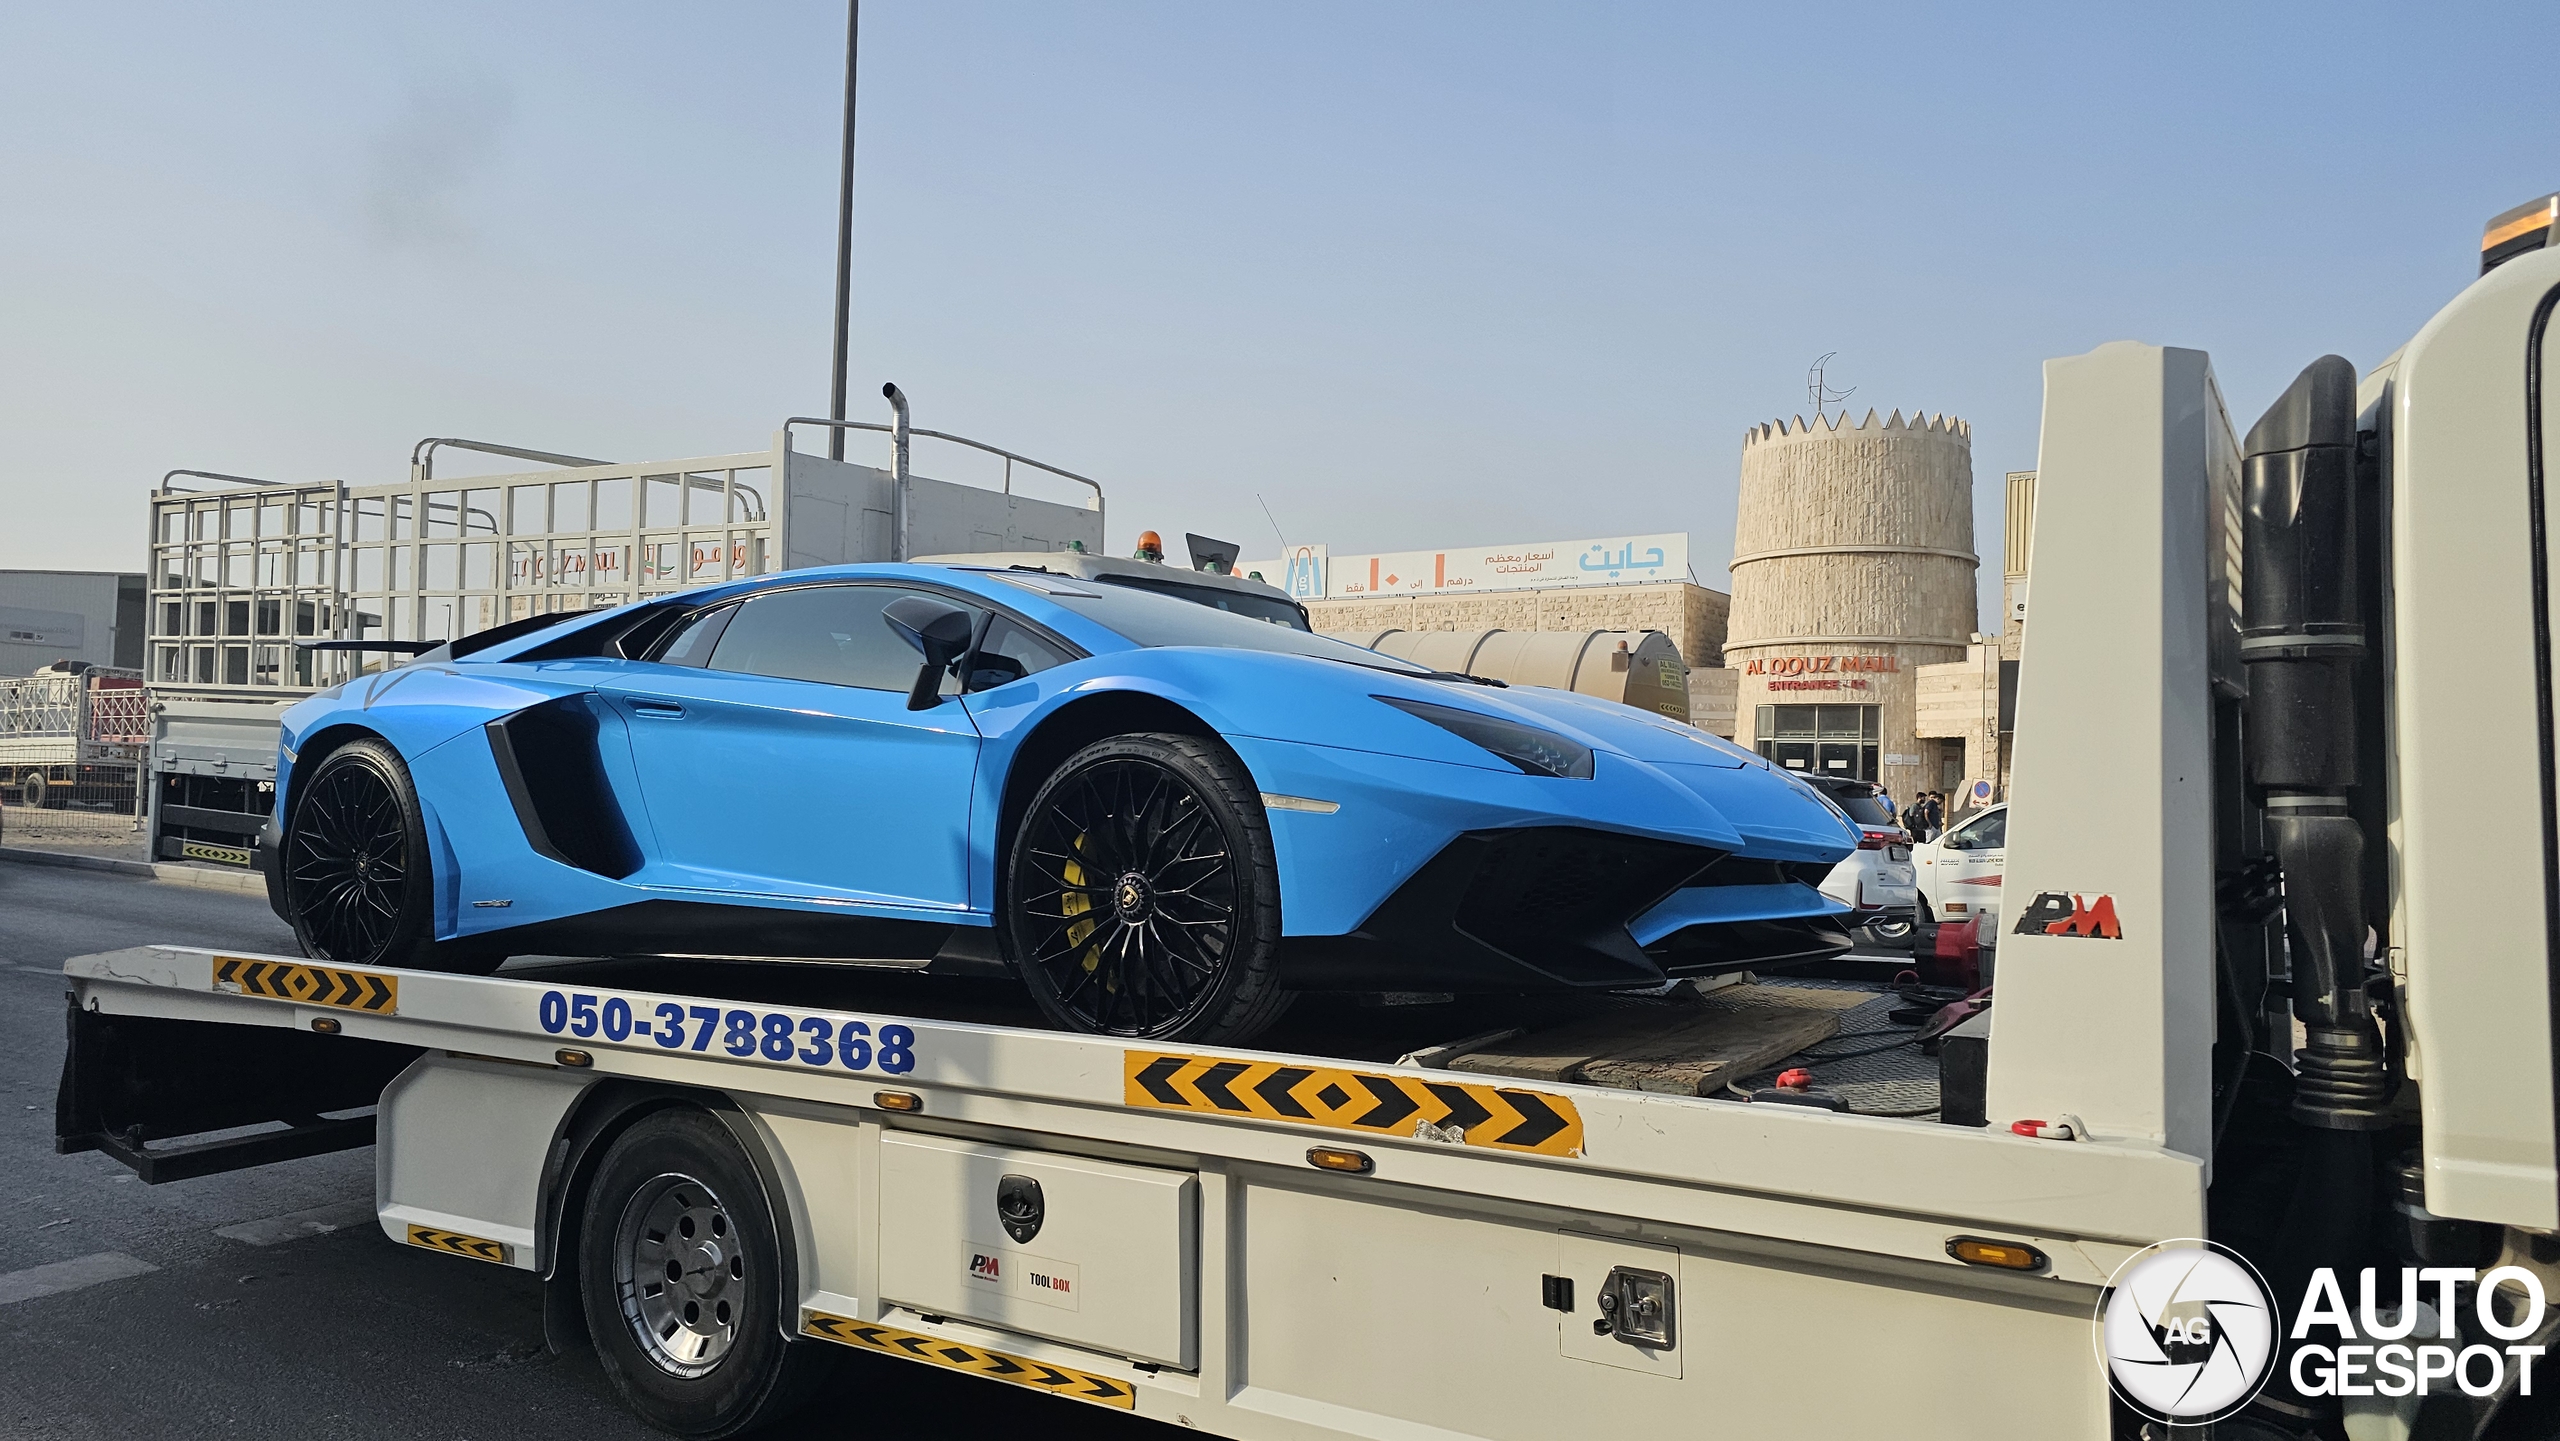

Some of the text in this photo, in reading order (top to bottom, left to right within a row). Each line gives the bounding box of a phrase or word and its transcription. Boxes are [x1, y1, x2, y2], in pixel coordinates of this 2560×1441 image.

[1485, 548, 1554, 565] أسعار معظم
[1579, 541, 1665, 578] جايت
[1496, 563, 1542, 575] المنتجات
[1345, 582, 1365, 593] فقط
[1446, 577, 1474, 588] درهم
[1746, 656, 1900, 677] AL QOUZ MALL
[1768, 680, 1838, 691] ENTRANCE
[2011, 892, 2122, 939] PM
[539, 990, 916, 1075] 050-3788368
[969, 1253, 1000, 1277] PM
[1030, 1272, 1071, 1293] TOOL BOX
